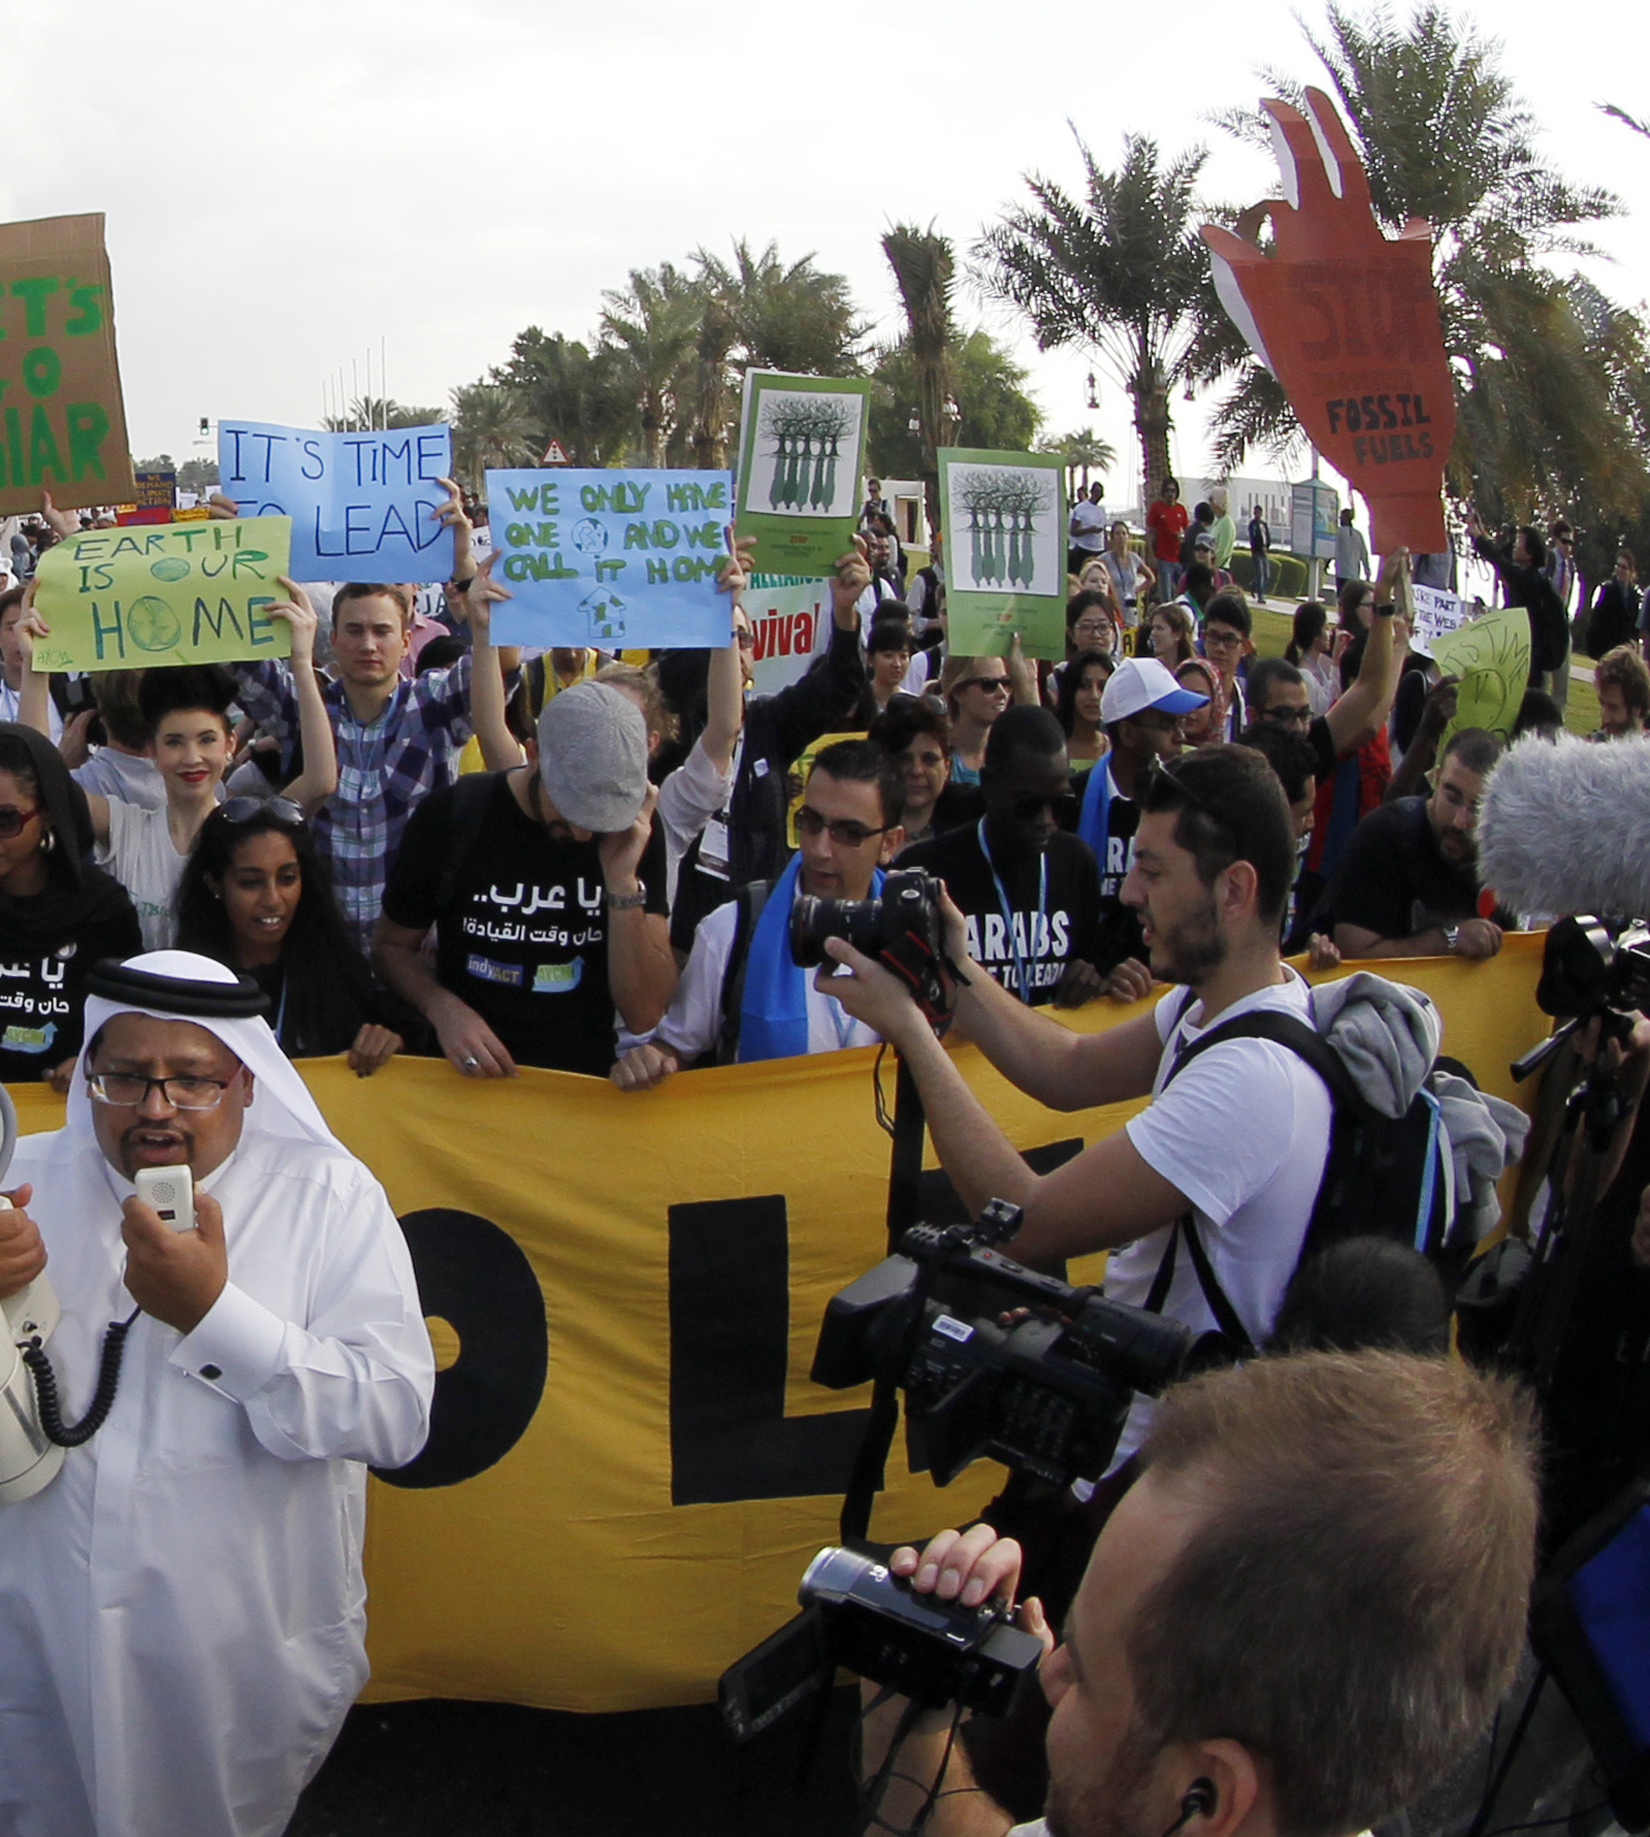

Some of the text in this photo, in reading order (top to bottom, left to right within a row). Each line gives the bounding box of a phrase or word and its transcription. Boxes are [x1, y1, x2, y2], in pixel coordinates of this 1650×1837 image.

[1326, 394, 1431, 434] FOSSIL
[225, 430, 324, 482] IT'S
[1354, 432, 1435, 466] FUELS
[506, 481, 727, 515] WE ONLY HAVE
[74, 525, 242, 561] EARTH
[316, 500, 444, 556] LEAD
[505, 522, 560, 548] ONE
[624, 519, 679, 549] AND
[683, 521, 722, 549] WE
[79, 563, 114, 593] IS
[504, 552, 580, 582] CALL
[1434, 596, 1456, 612] PART
[92, 595, 276, 660] HOME
[1434, 614, 1457, 629] WEB
[576, 877, 602, 916] يا
[529, 925, 569, 946] وقت
[573, 927, 603, 946] حان
[965, 910, 1070, 962] ARABS
[41, 957, 66, 989] يا
[467, 955, 521, 983] indyACT
[38, 997, 70, 1015] حان
